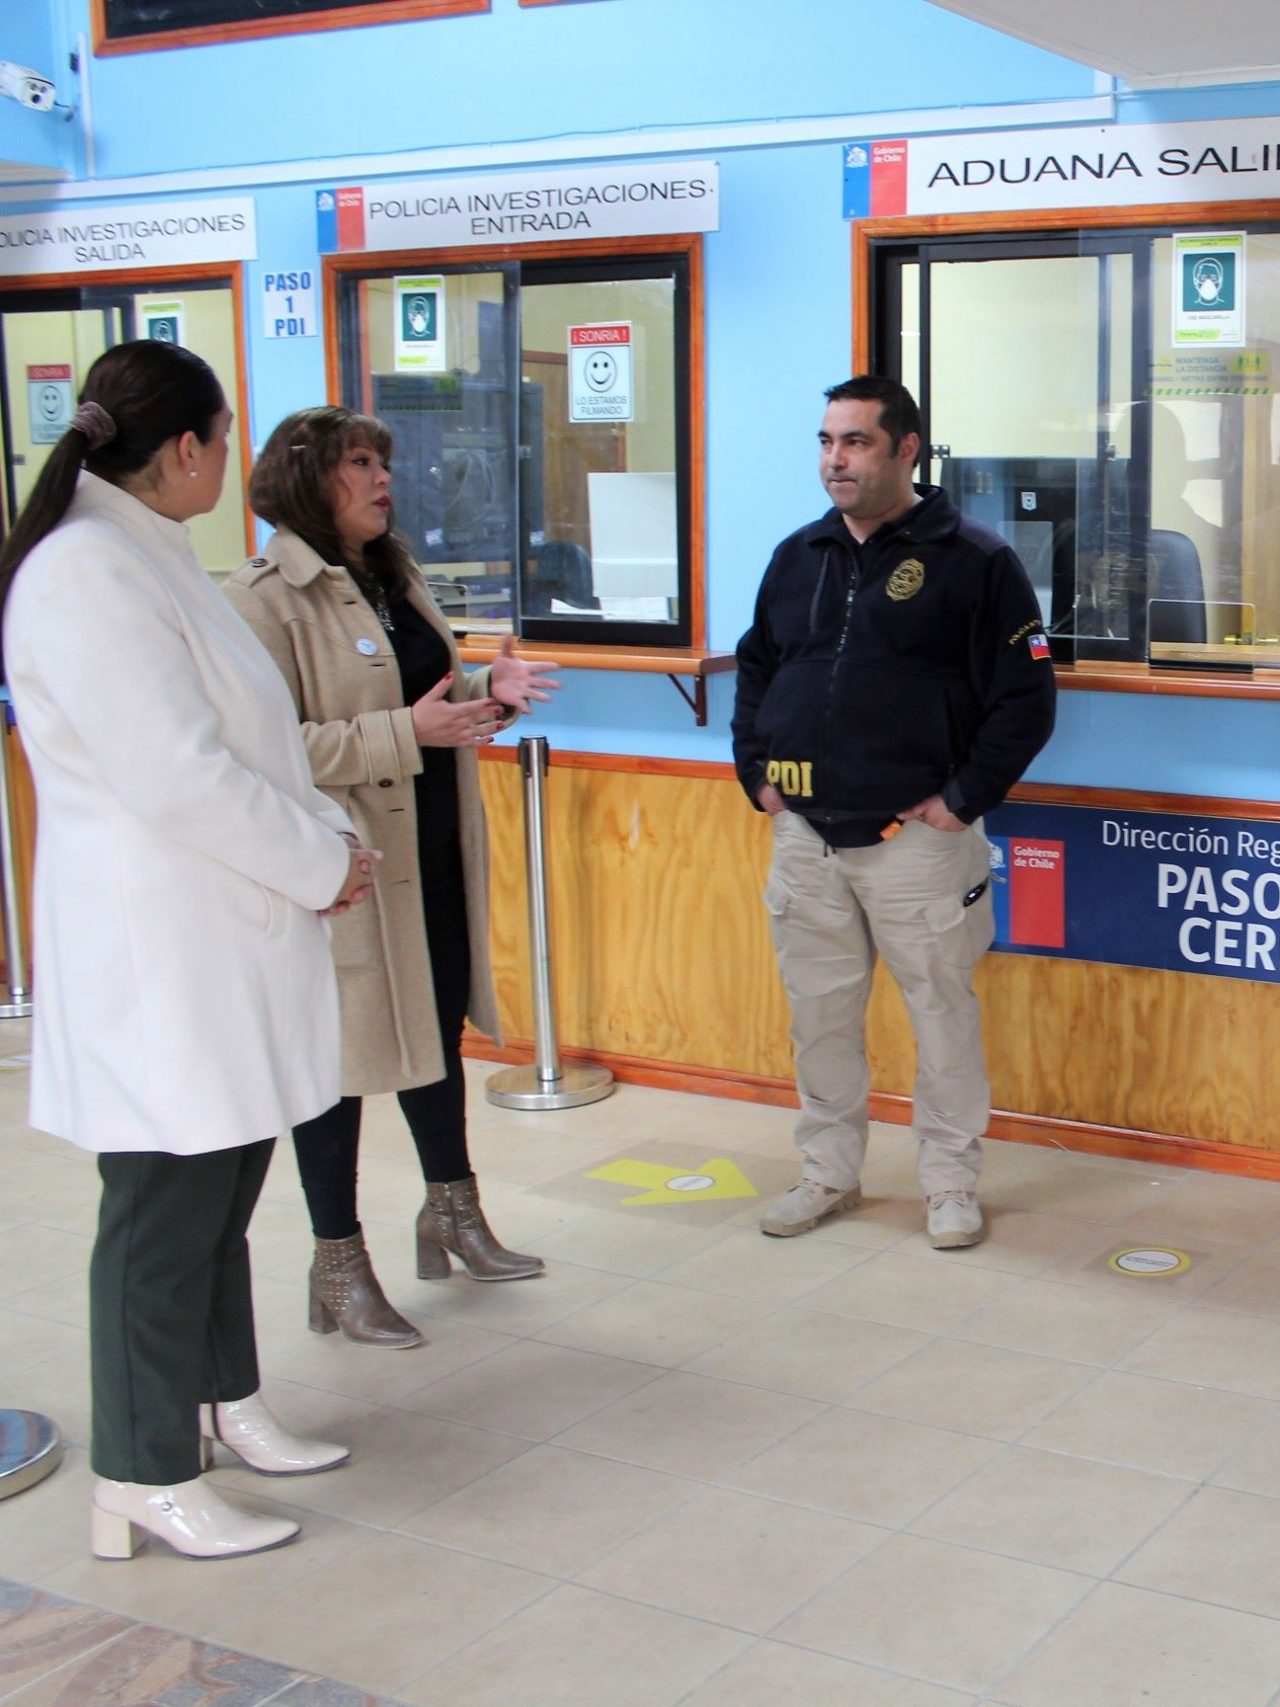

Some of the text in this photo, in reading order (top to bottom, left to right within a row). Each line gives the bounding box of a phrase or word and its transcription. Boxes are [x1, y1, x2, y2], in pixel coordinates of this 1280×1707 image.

[927, 151, 1142, 188] ADUANA
[369, 178, 707, 220] POLICIA INVESTIGACIONES
[58, 213, 246, 244] INVESTIGACIONES
[471, 211, 592, 236] ENTRADA
[75, 243, 146, 263] SALIDA
[264, 271, 311, 292] PASO
[285, 296, 294, 313] 1
[275, 318, 305, 337] PDI
[1102, 818, 1230, 857] Dirección
[1014, 846, 1060, 859] Gobierno
[1014, 857, 1056, 869] de Chile
